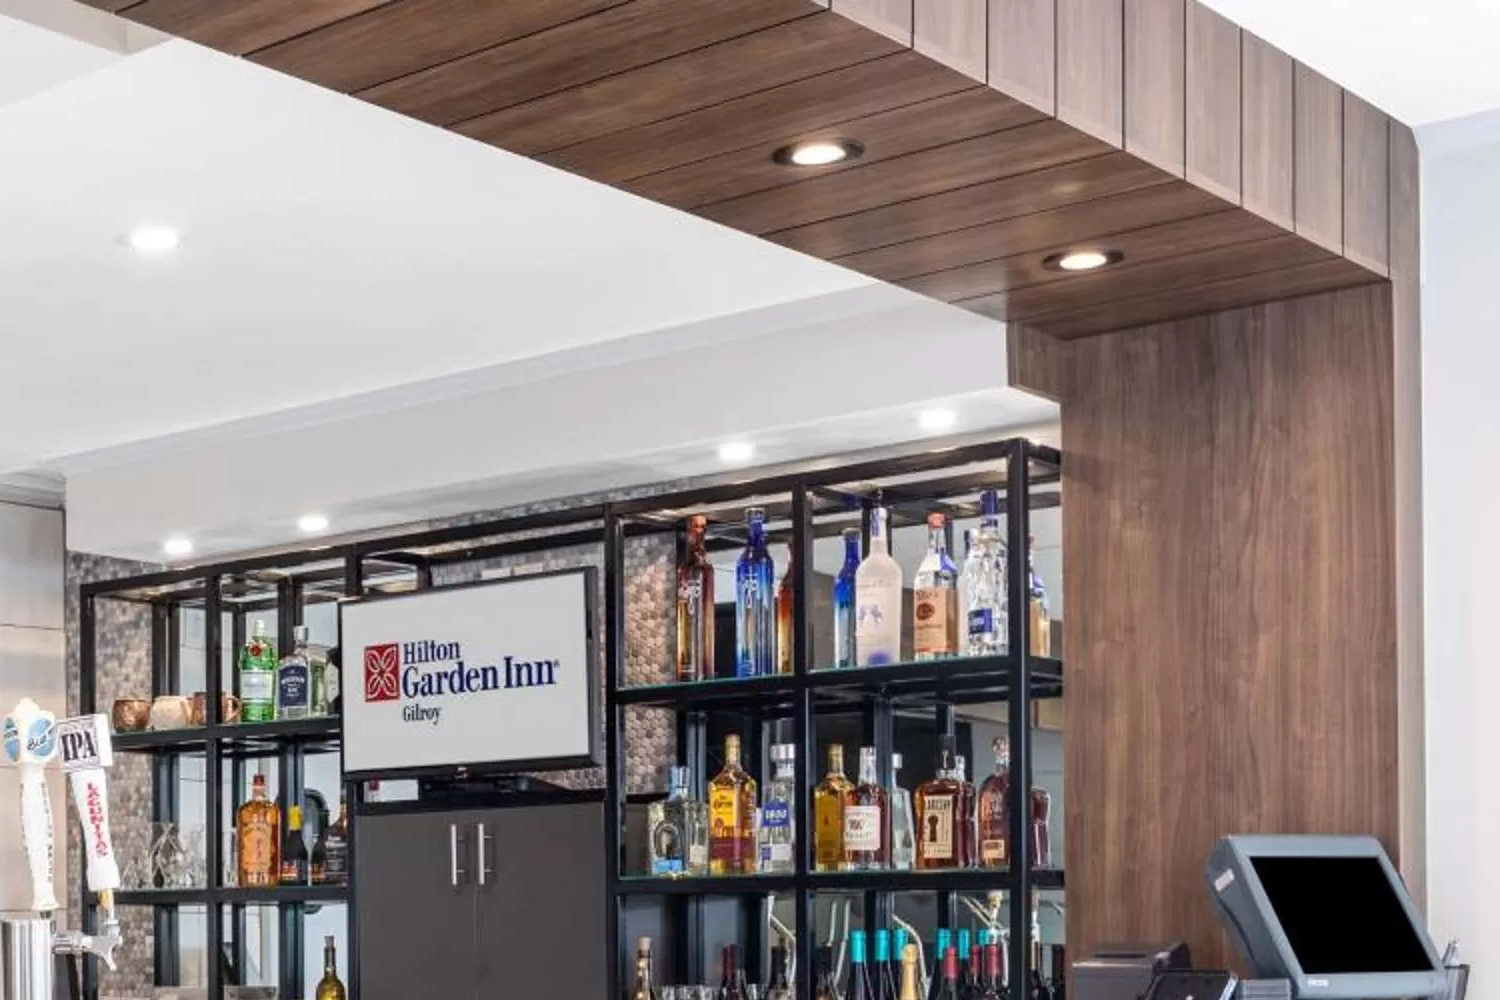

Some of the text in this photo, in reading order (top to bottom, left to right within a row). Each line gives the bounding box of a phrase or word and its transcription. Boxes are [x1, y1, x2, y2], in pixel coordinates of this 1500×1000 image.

[402, 639, 461, 665] Hilton
[402, 659, 500, 699] Garden
[402, 703, 441, 725] Gilroy
[61, 730, 97, 762] IPA
